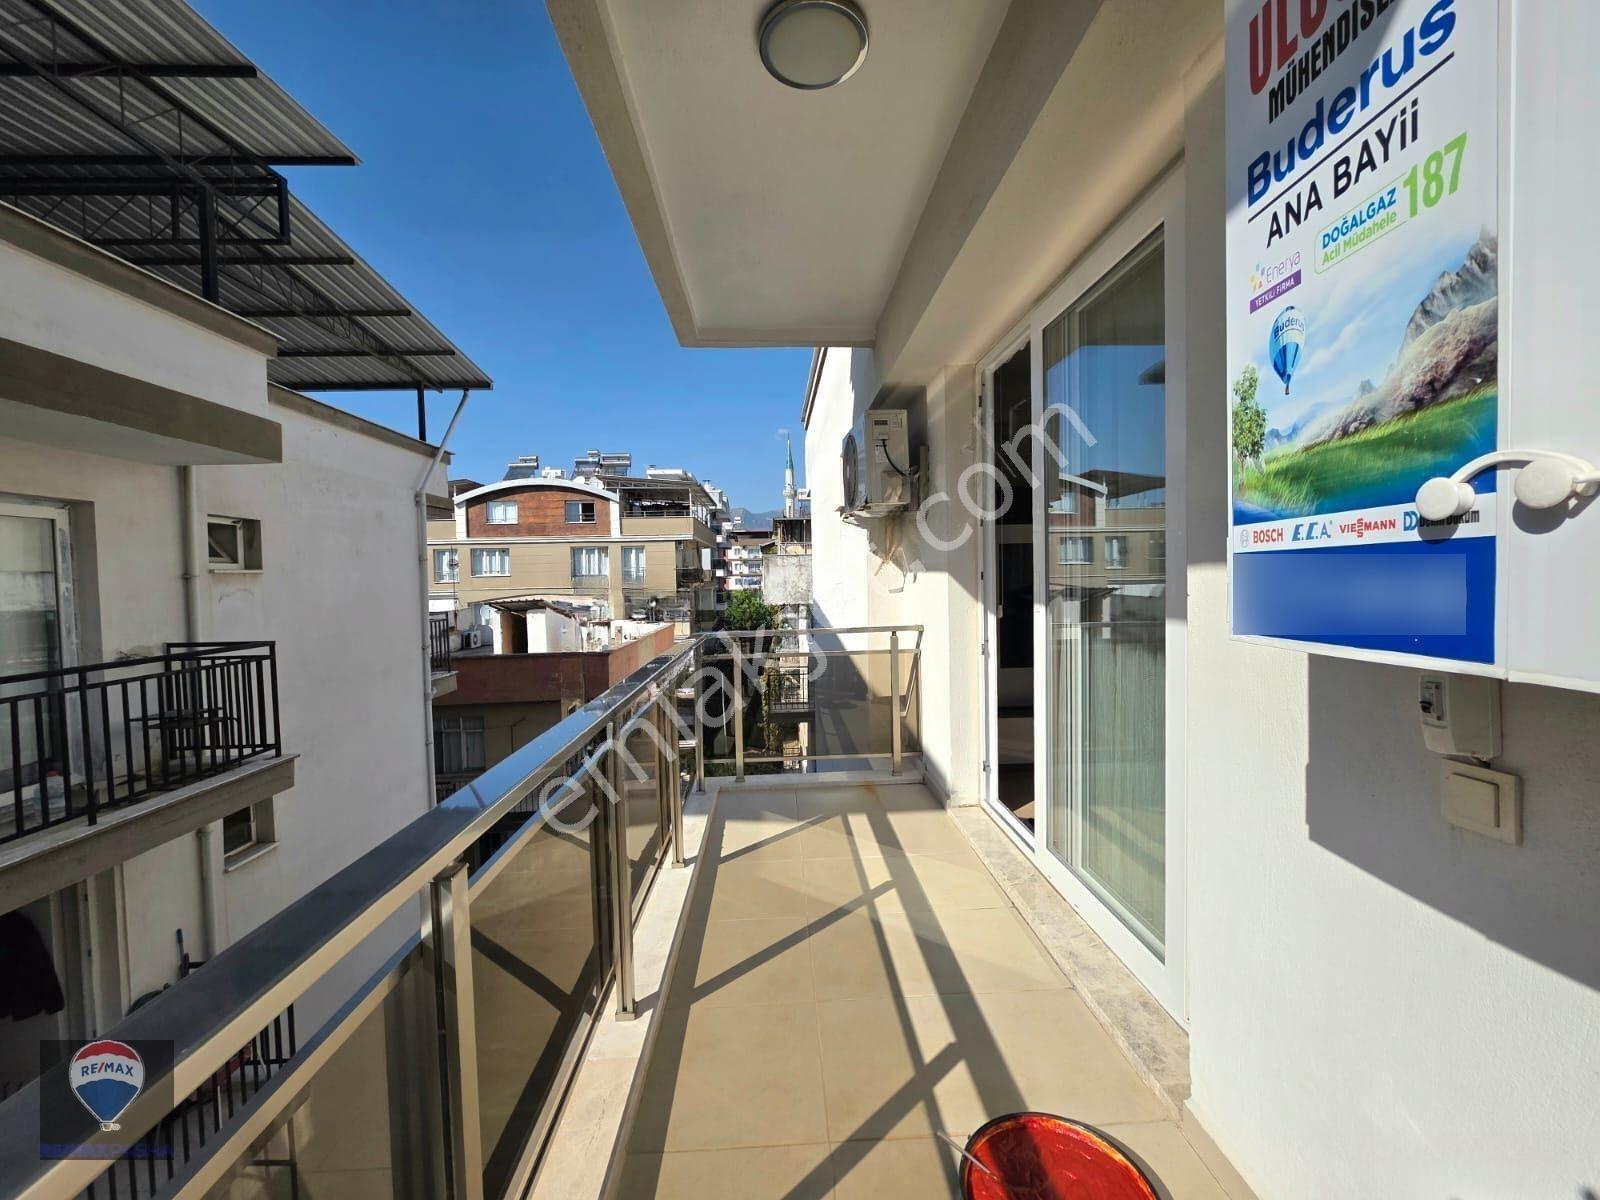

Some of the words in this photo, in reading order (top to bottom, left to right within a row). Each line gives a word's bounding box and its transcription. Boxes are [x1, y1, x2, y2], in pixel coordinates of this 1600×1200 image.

[1248, 0, 1457, 208] Buderus
[1267, 180, 1323, 248] ANA
[1322, 187, 1397, 250] DOĞALGAZ
[1403, 132, 1468, 219] 187
[1266, 251, 1301, 284] Enerya
[1322, 243, 1341, 265] Acil
[1253, 528, 1284, 544] BOSCH
[1339, 517, 1397, 538] VIESSMANN
